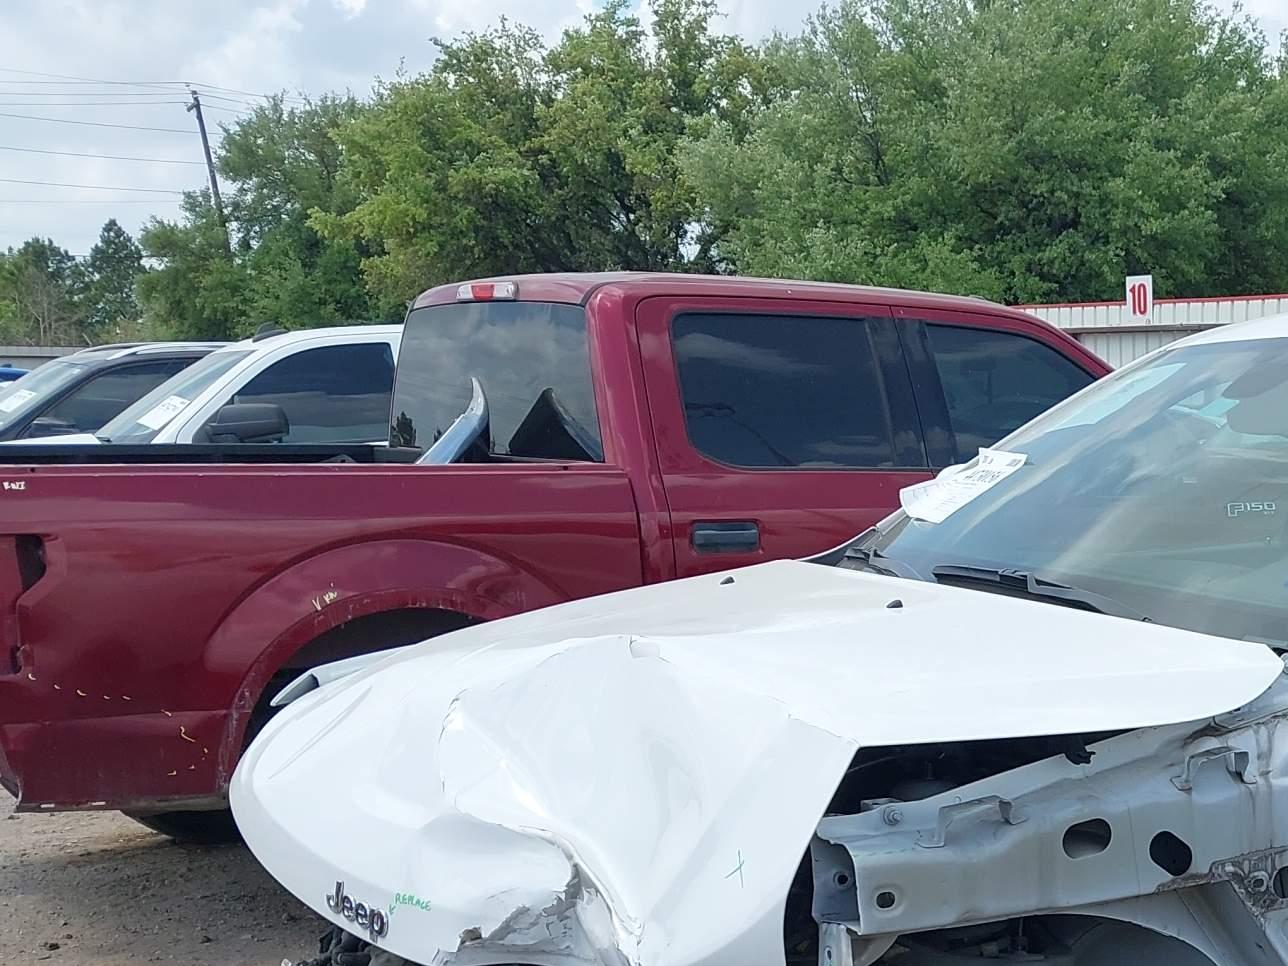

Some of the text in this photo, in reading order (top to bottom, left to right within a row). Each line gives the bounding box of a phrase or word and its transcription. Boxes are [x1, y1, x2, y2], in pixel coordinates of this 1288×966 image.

[1128, 282, 1148, 316] 10
[325, 880, 390, 944] Jeep
[395, 892, 432, 912] REPLACE
